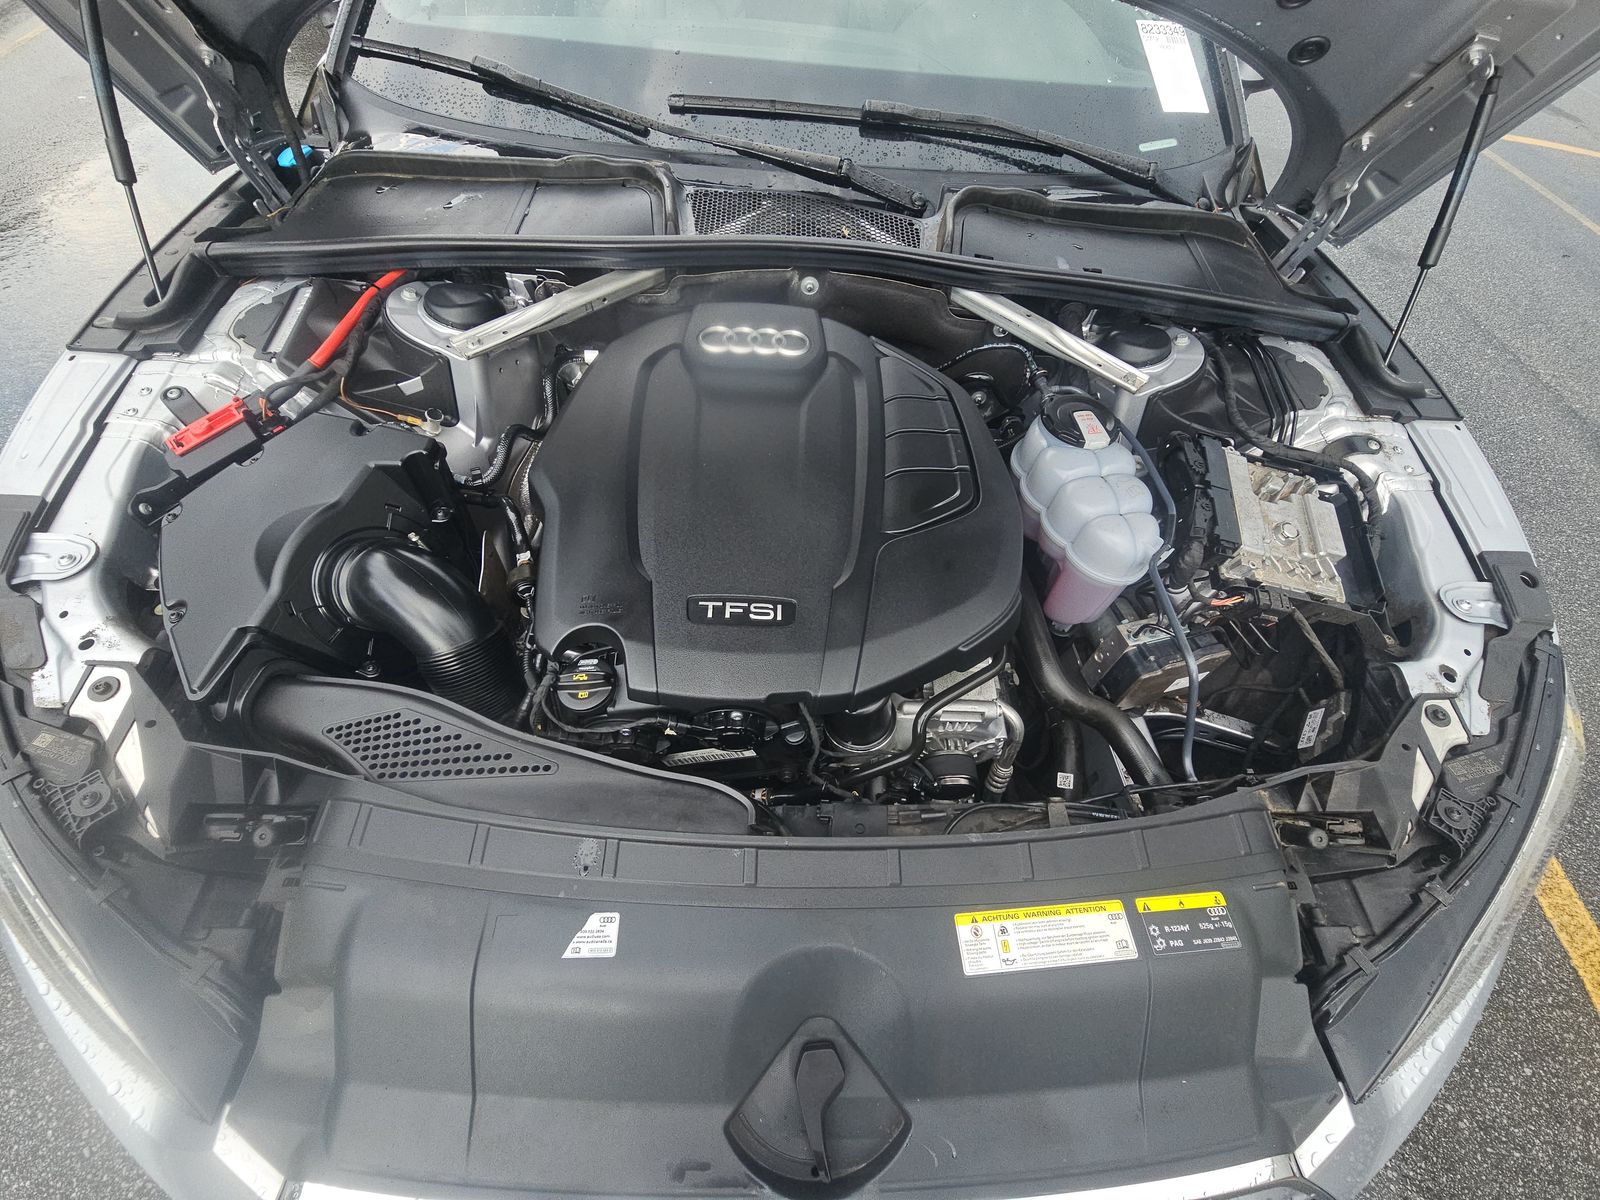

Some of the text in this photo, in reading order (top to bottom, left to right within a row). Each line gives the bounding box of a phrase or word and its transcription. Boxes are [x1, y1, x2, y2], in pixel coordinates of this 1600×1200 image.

[1140, 23, 1185, 36] 8233349
[698, 601, 782, 621] TFSI
[982, 913, 1020, 922] ACHTUNG
[1023, 909, 1062, 918] WARNING
[1065, 905, 1107, 915] ATTENTION
